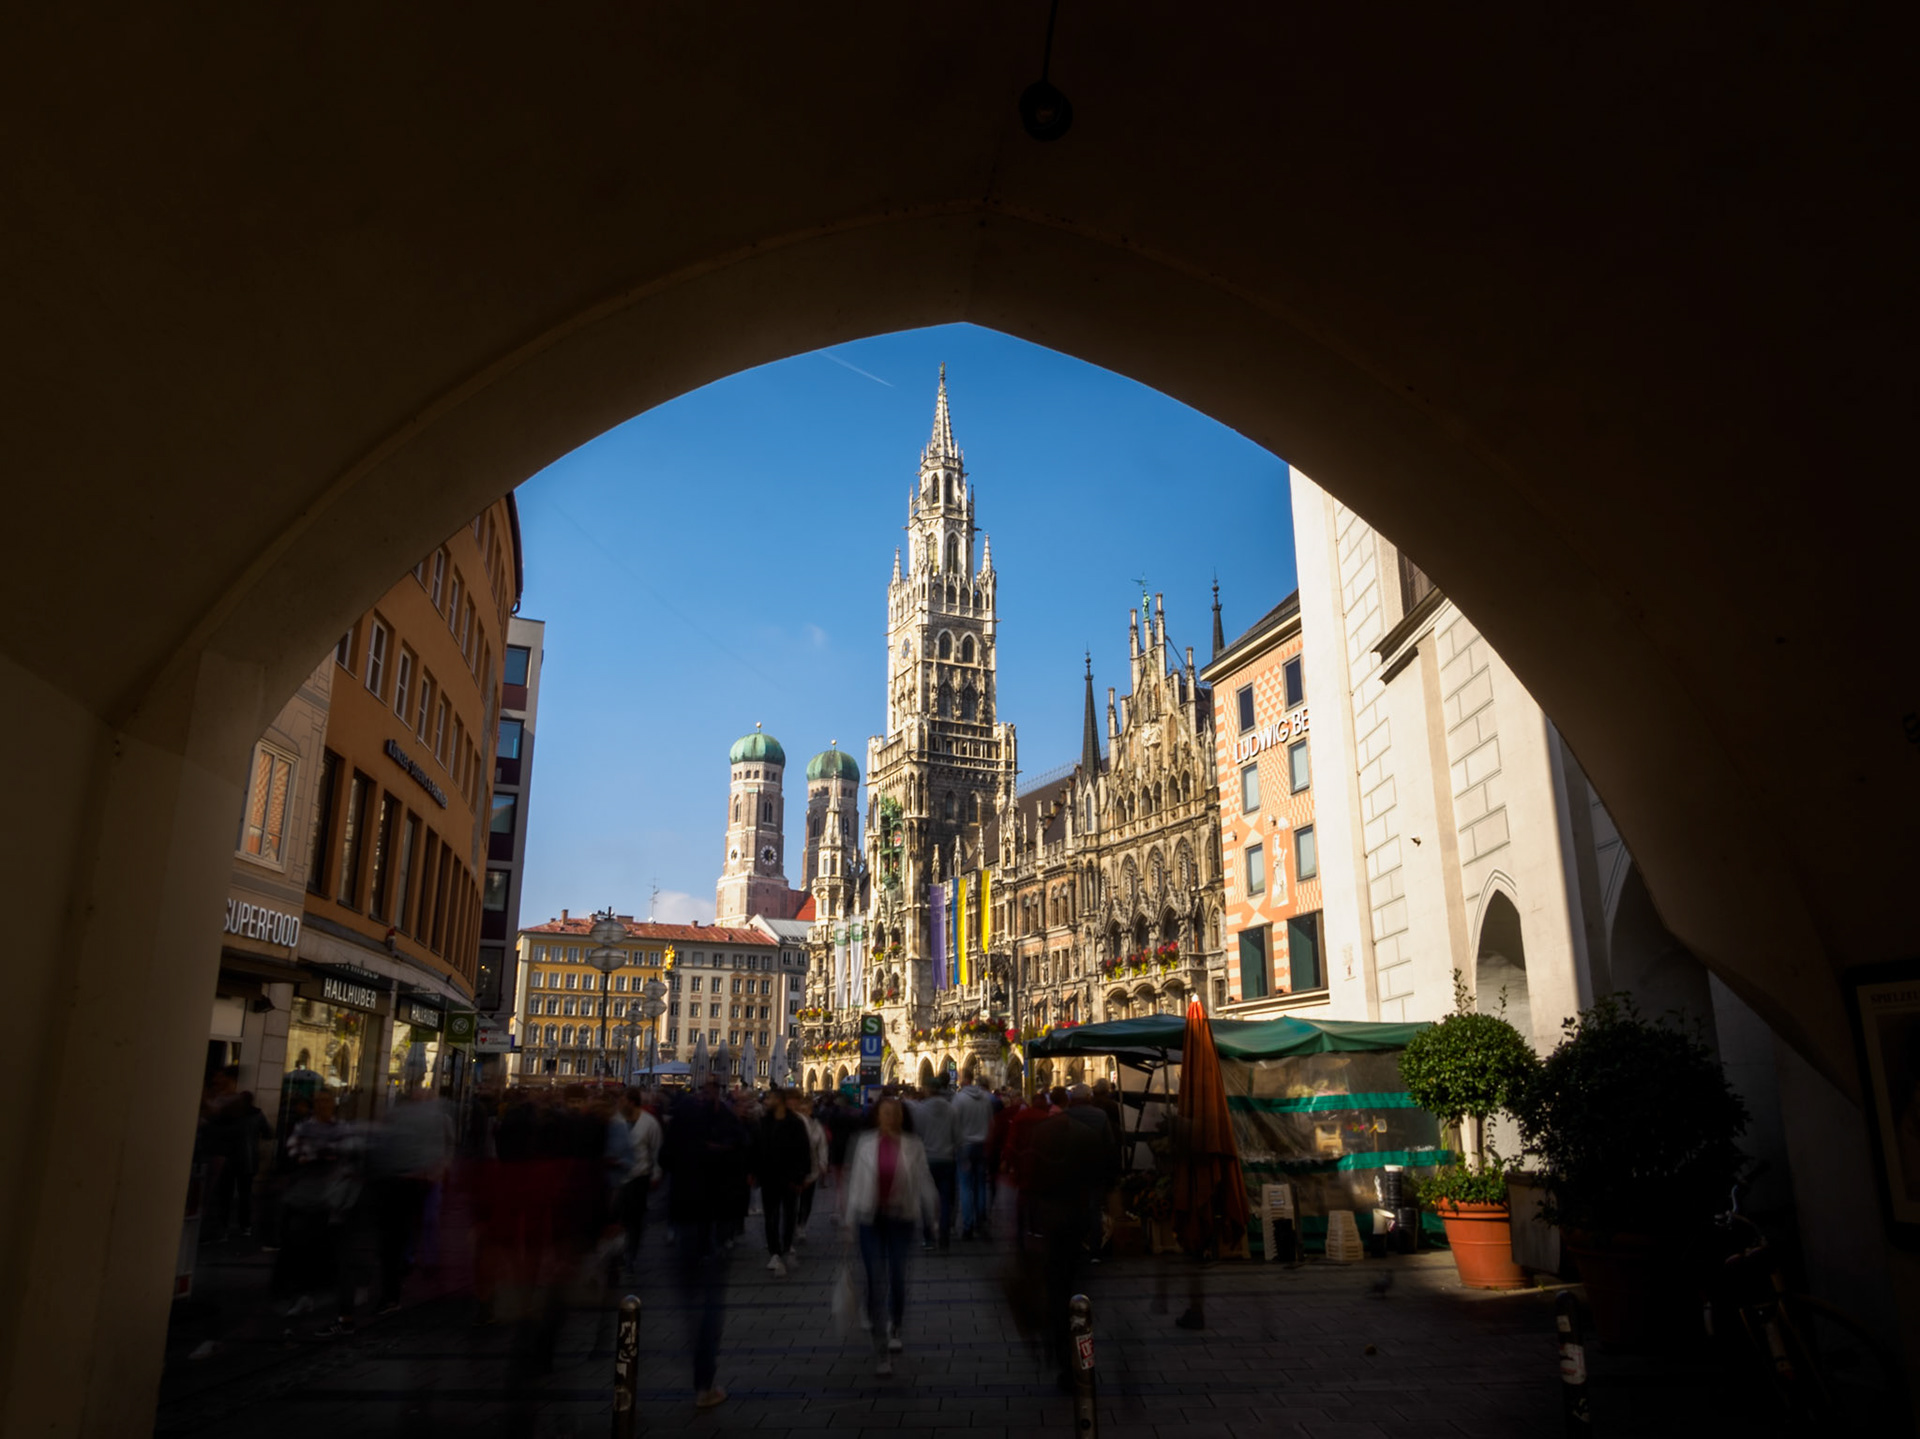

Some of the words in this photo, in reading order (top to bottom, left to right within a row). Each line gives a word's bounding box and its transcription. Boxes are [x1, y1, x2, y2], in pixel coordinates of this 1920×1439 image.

[1234, 718, 1290, 764] LUDWIG
[323, 977, 377, 1009] HALLHUBER
[865, 1017, 879, 1034] S
[865, 1038, 878, 1054] U
